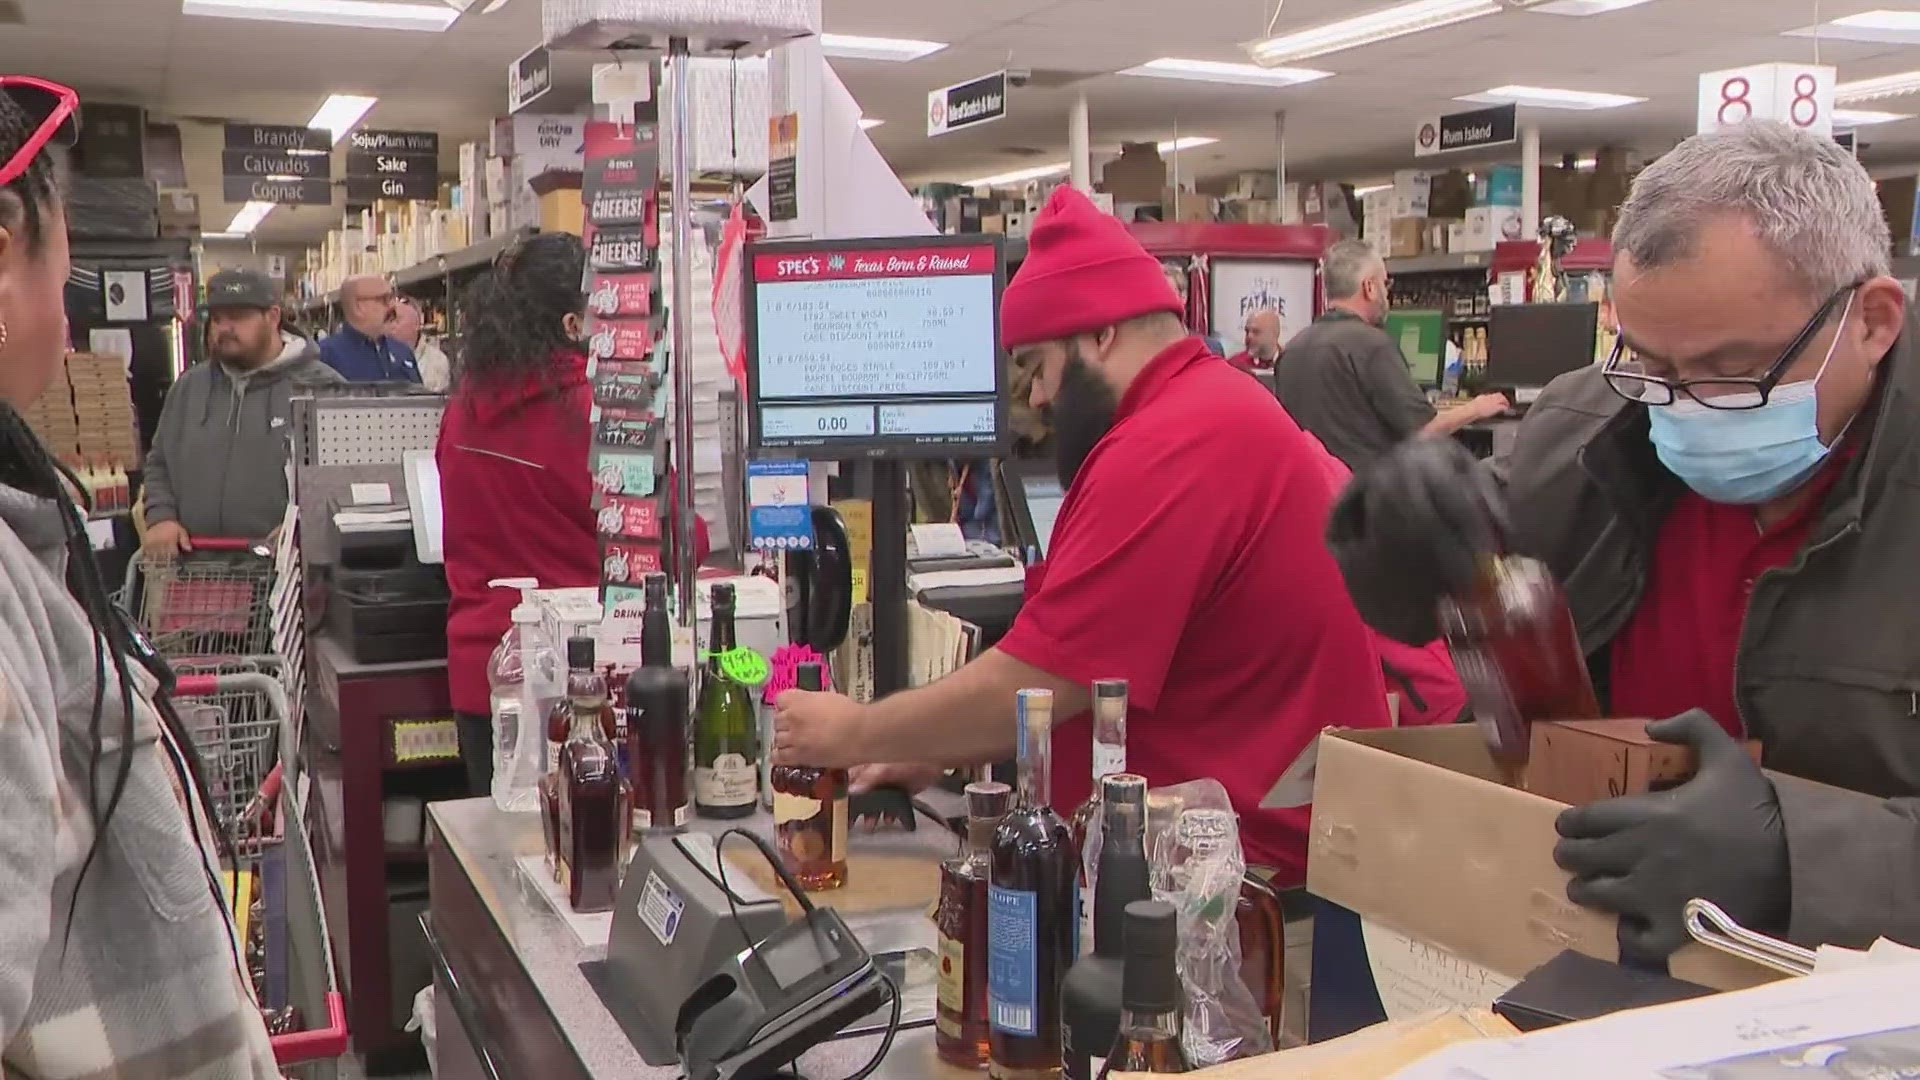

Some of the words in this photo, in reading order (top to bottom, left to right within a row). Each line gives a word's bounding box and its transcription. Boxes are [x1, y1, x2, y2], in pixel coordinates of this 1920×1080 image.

[1717, 76, 1752, 126] 8
[1790, 73, 1818, 128] 8
[253, 127, 305, 148] Brandy
[351, 132, 406, 149] Soju/Plum
[407, 135, 434, 148] Wine
[1442, 129, 1463, 145] Rum
[1464, 124, 1492, 141] Island
[243, 156, 310, 174] Calvados
[376, 156, 408, 173] Sake
[251, 182, 304, 200] Cognac
[381, 179, 404, 195] Gin
[592, 197, 643, 220] CHEERS!
[591, 241, 642, 263] CHEERS!
[777, 255, 821, 276] SPEC'S
[854, 257, 884, 273] Texas
[886, 255, 915, 272] Born
[916, 255, 927, 271] &
[928, 253, 971, 270] Raised
[817, 416, 848, 431] 0.00
[1409, 937, 1489, 986] FAMILY
